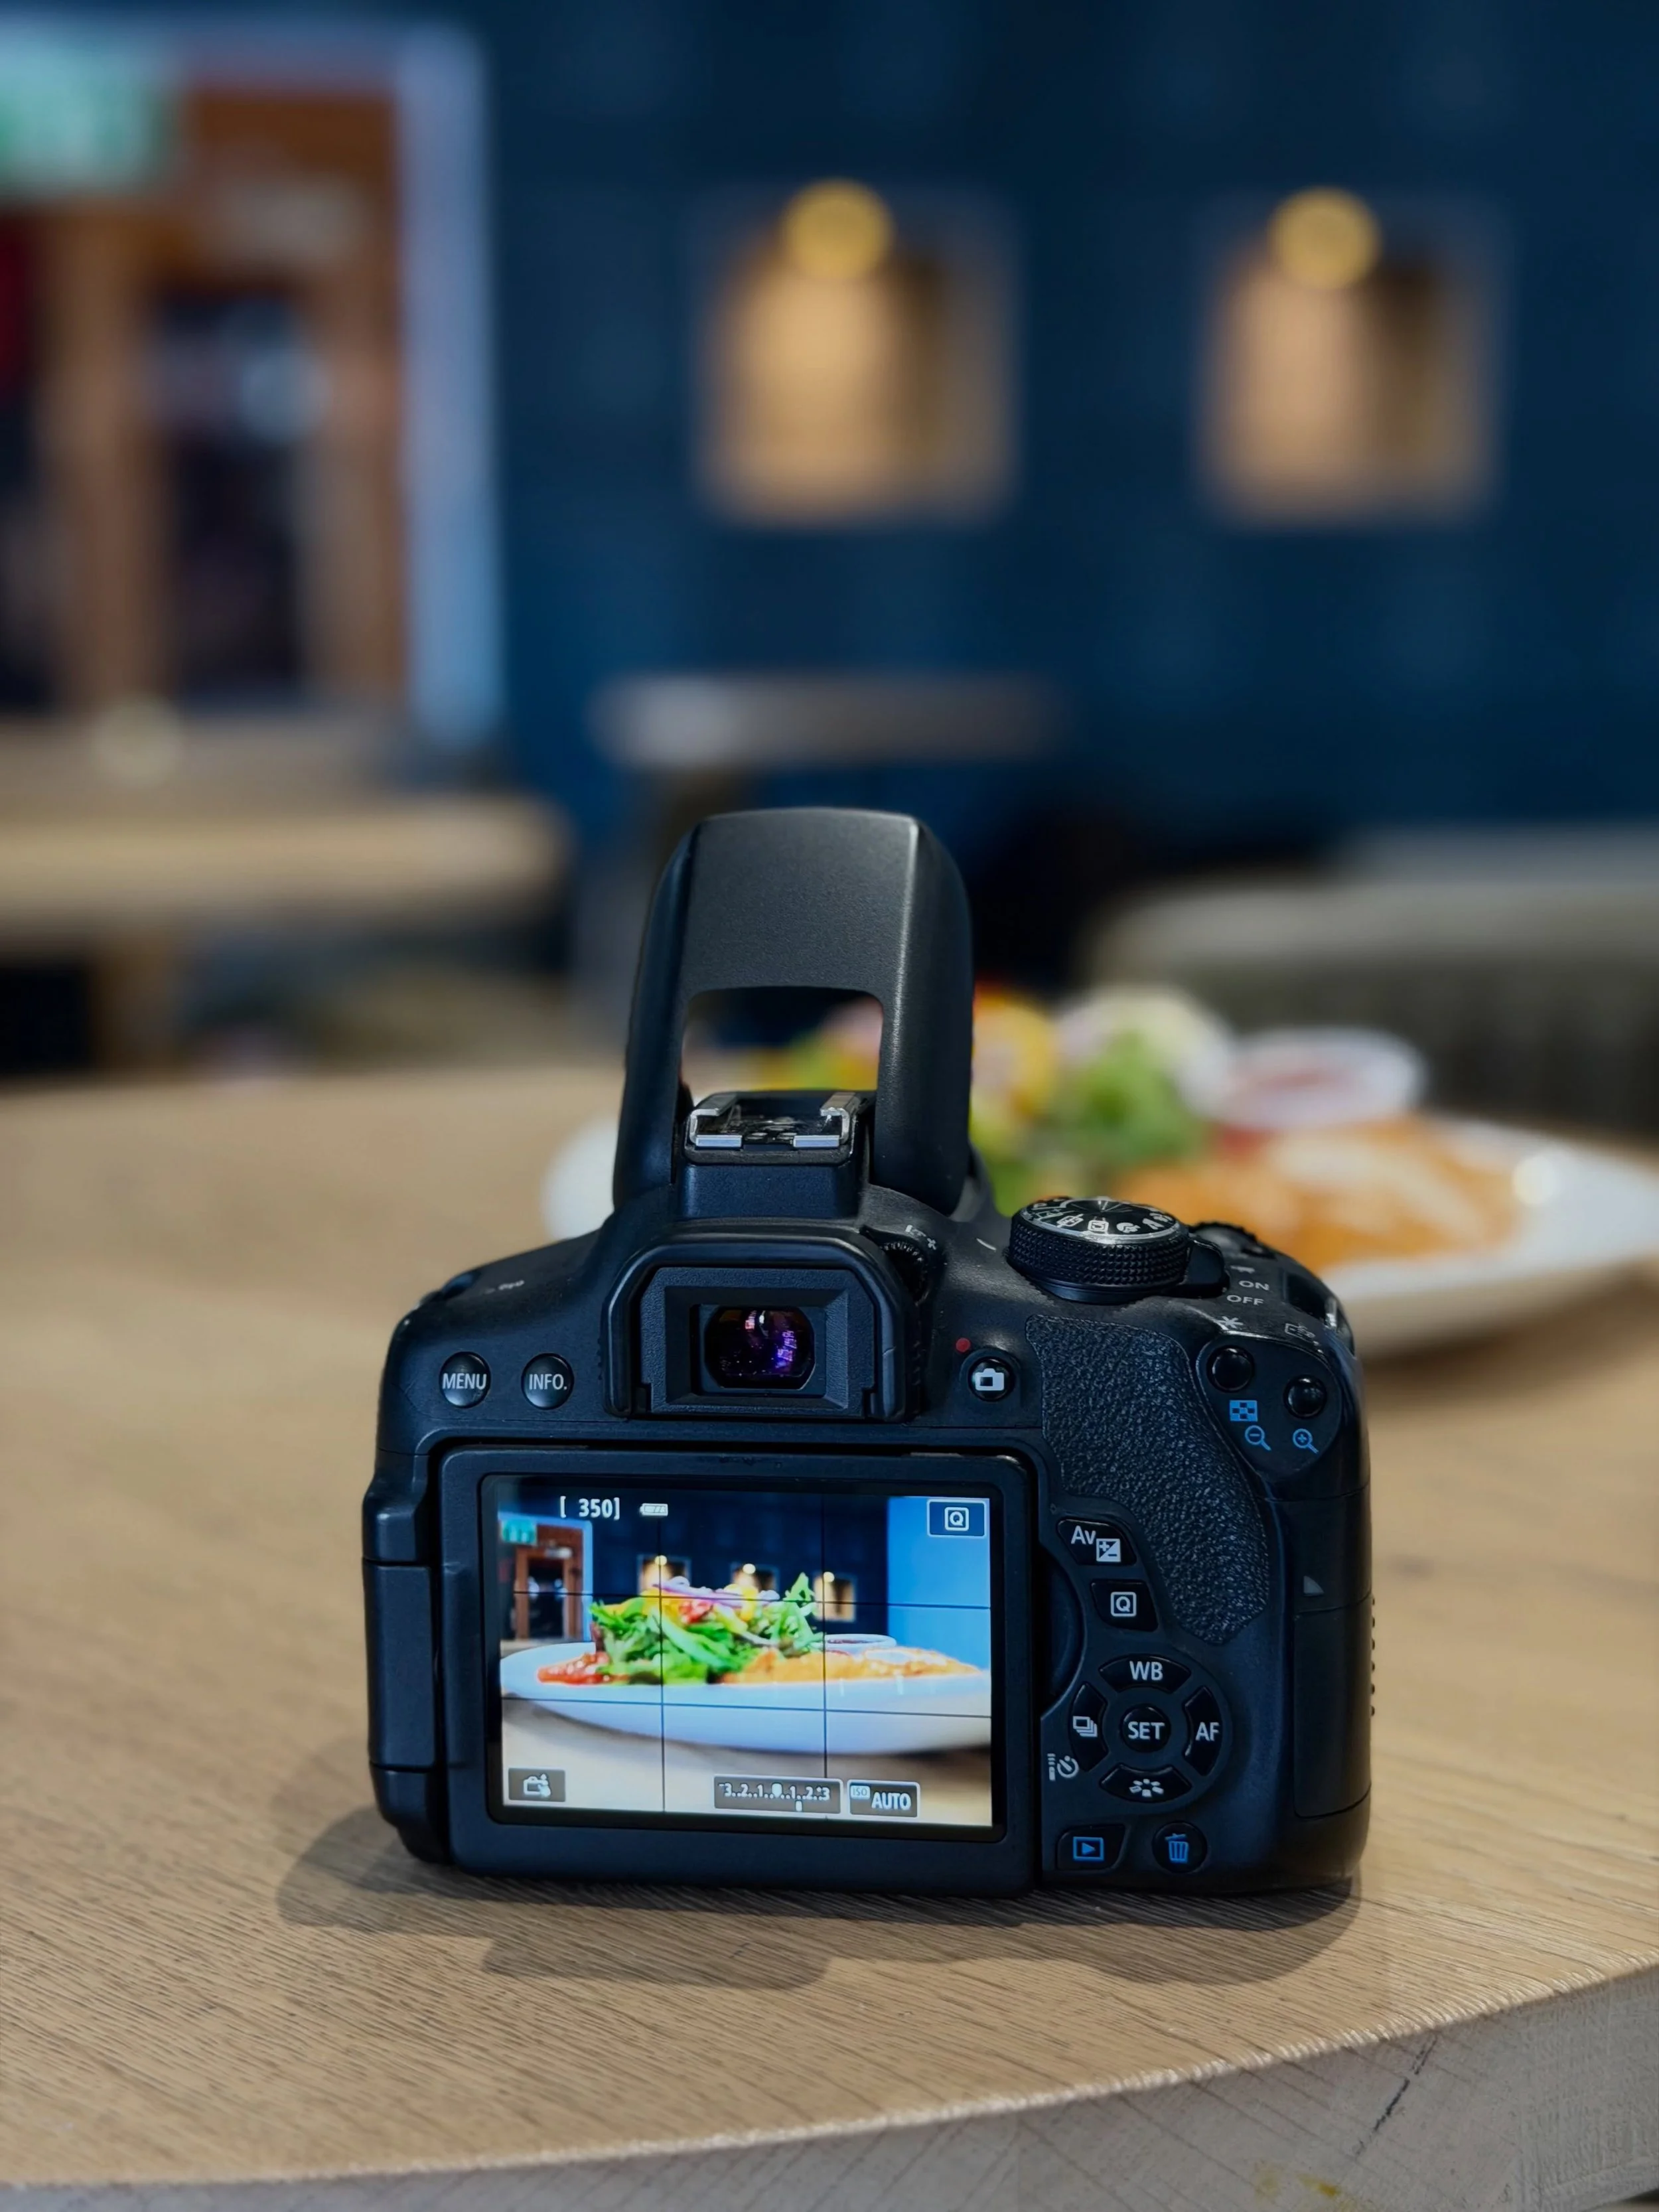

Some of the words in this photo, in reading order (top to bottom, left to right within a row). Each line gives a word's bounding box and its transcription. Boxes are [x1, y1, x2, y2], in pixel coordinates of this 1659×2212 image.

[1238, 1280, 1269, 1291] ON
[1226, 1295, 1264, 1305] OFF
[442, 1372, 487, 1390] MENU
[529, 1373, 567, 1390] INFO.
[1070, 1525, 1096, 1544] Av
[1129, 1660, 1163, 1680] WB
[1127, 1721, 1165, 1740] SET
[1195, 1721, 1220, 1741] AF
[853, 1787, 867, 1796] ISO
[871, 1791, 912, 1810] AUTO
